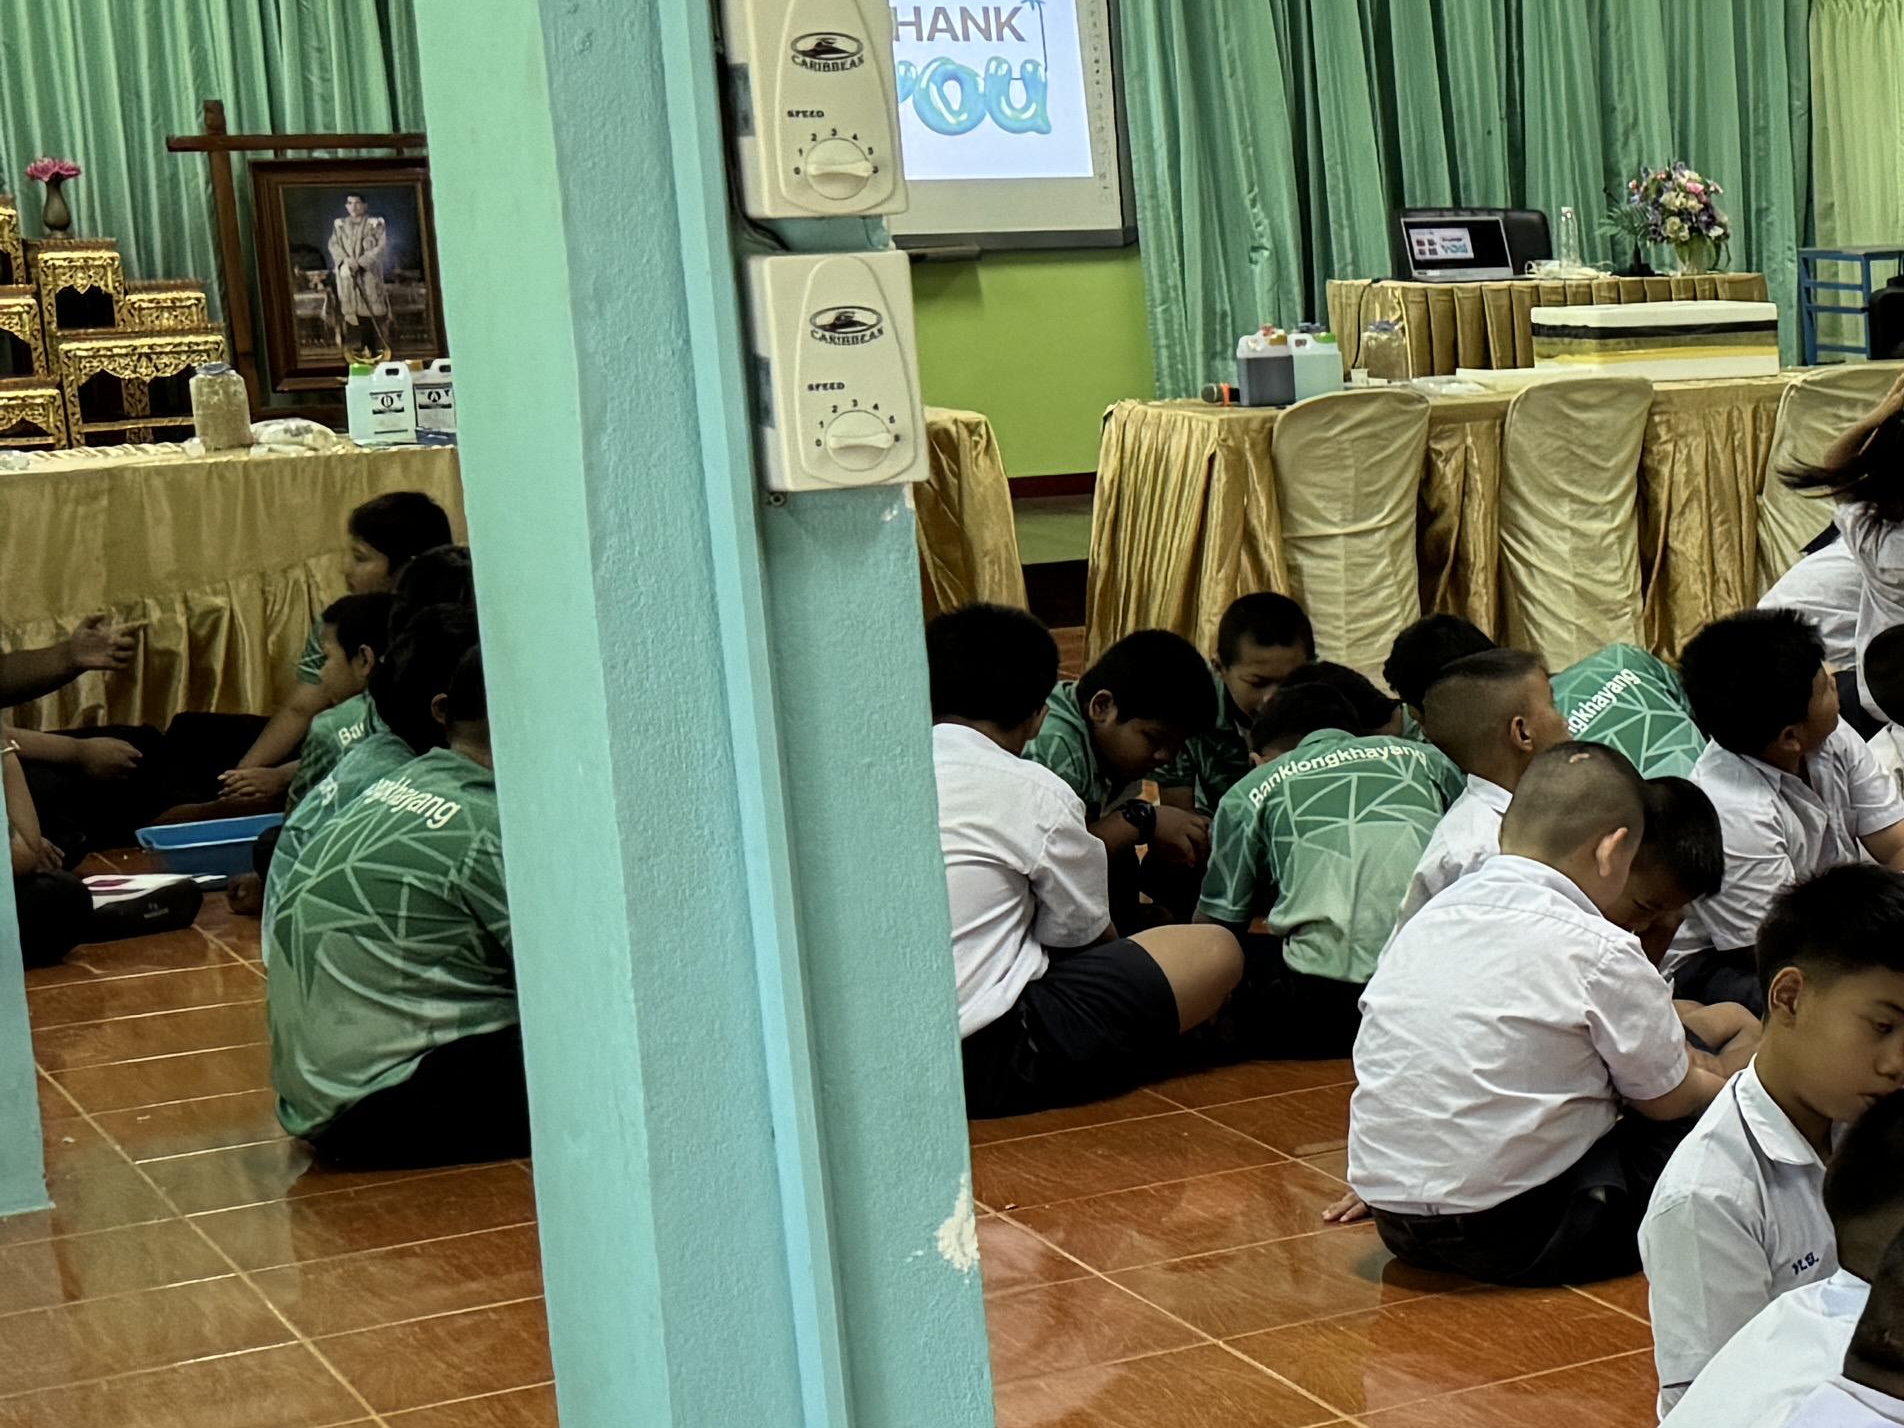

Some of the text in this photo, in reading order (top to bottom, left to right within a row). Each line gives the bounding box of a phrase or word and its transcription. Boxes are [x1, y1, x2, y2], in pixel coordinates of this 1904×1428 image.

[894, 6, 1027, 42] HANK
[790, 53, 865, 72] CARIBBEAN
[786, 109, 825, 118] SPEED
[810, 326, 884, 346] CARIBBEAN
[807, 382, 845, 392] SPEED
